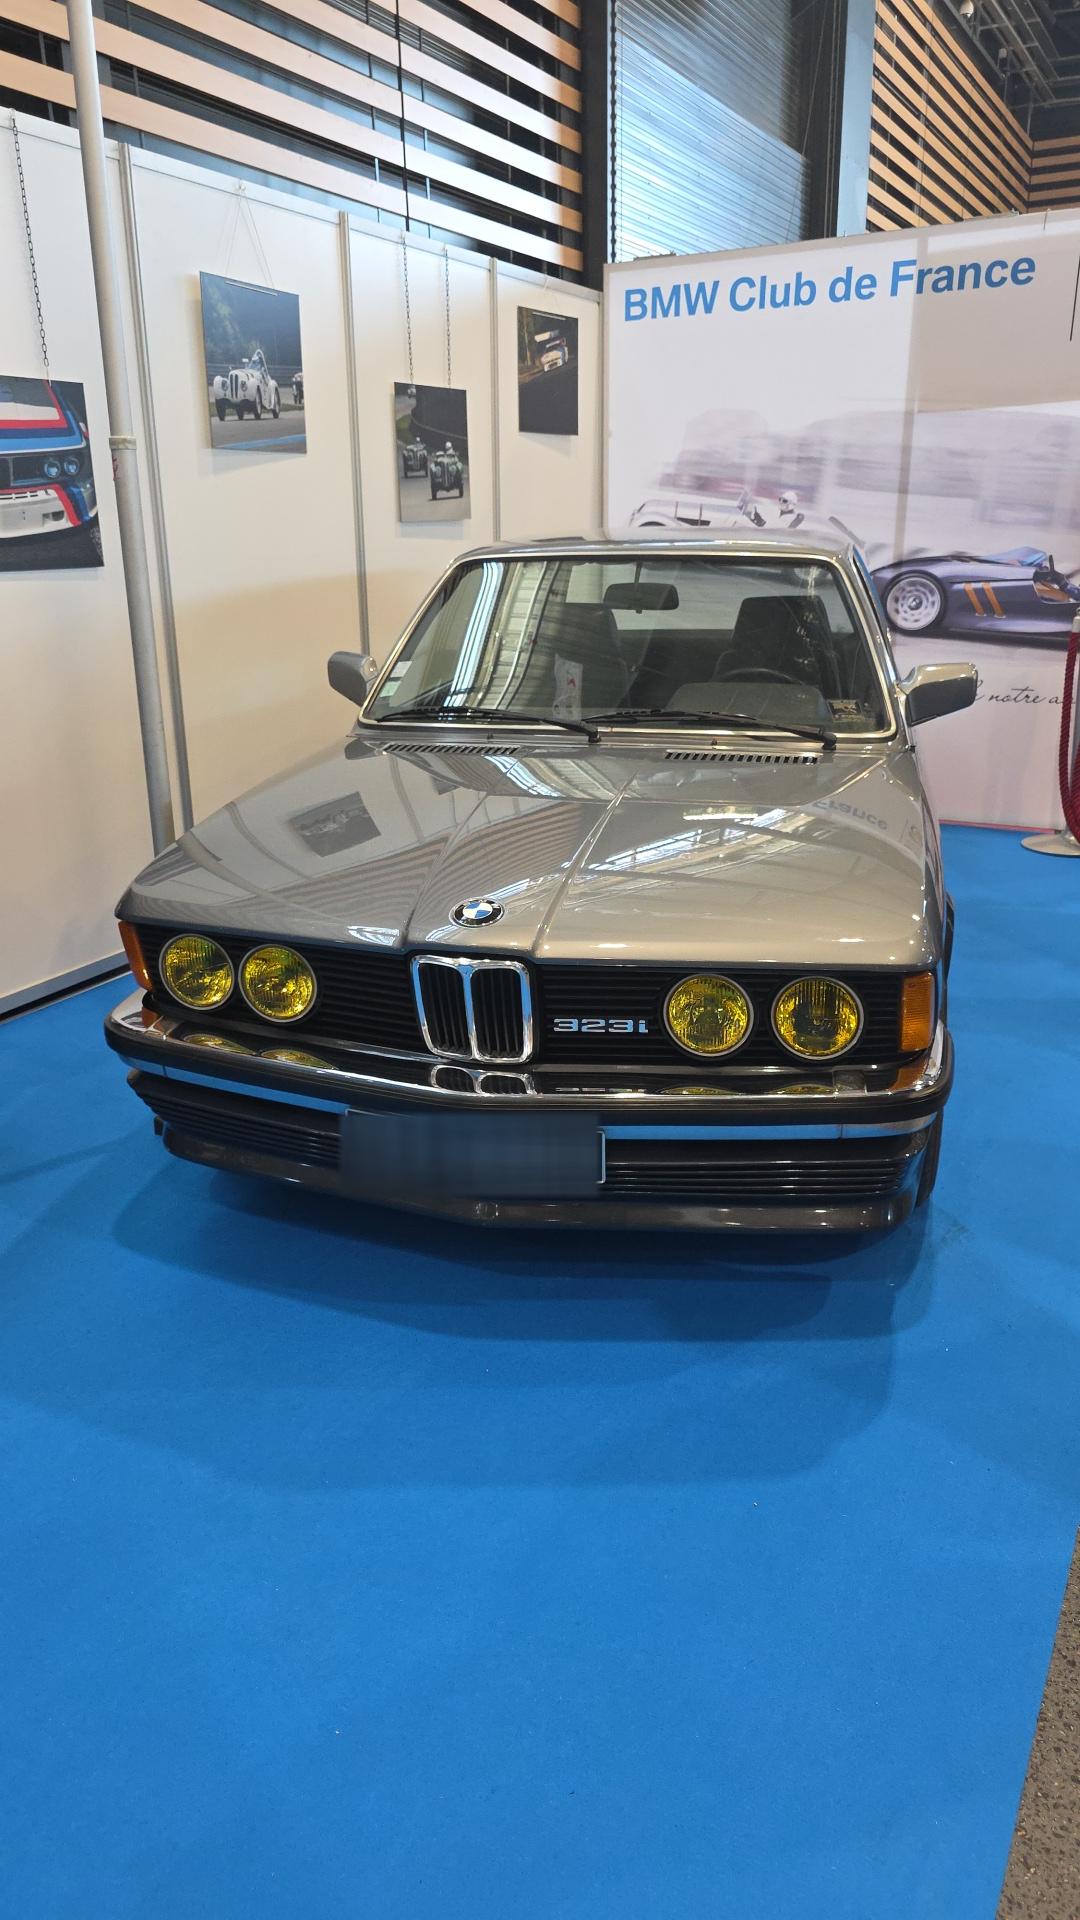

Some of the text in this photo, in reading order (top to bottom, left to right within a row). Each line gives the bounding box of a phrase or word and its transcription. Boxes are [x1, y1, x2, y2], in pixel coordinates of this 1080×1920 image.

[624, 256, 1036, 322] BMW Club de France
[988, 686, 1047, 704] notre
[553, 1018, 649, 1033] 323i
